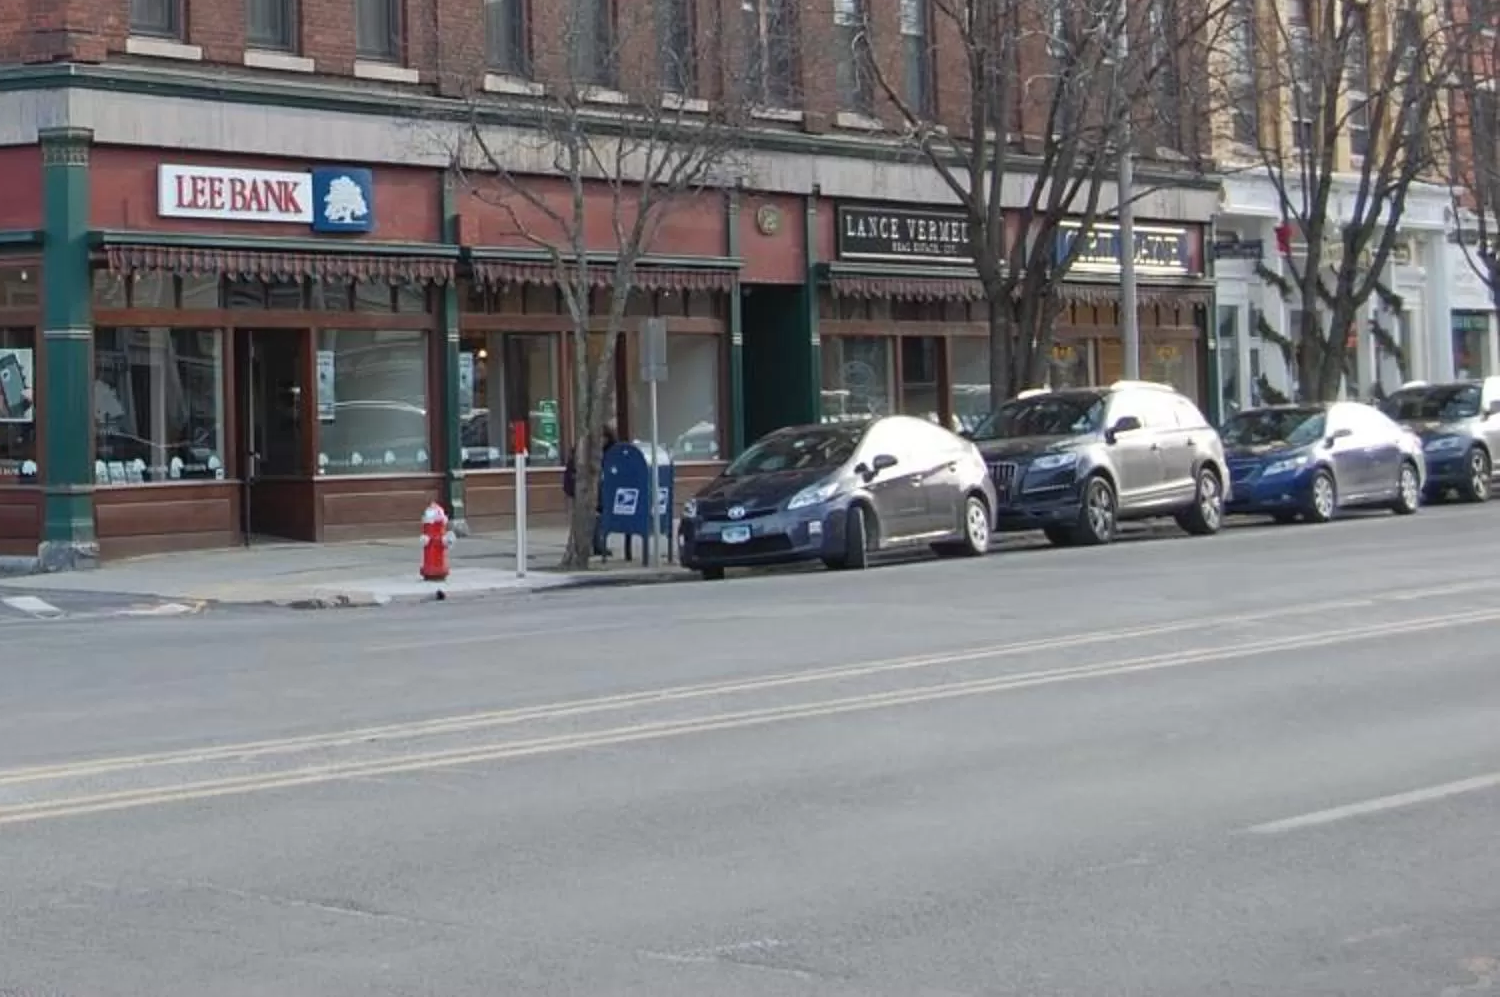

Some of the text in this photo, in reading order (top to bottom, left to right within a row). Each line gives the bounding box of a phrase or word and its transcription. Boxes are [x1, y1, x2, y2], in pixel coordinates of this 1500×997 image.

[175, 174, 303, 214] LEE BANK
[845, 214, 900, 239] LANCE
